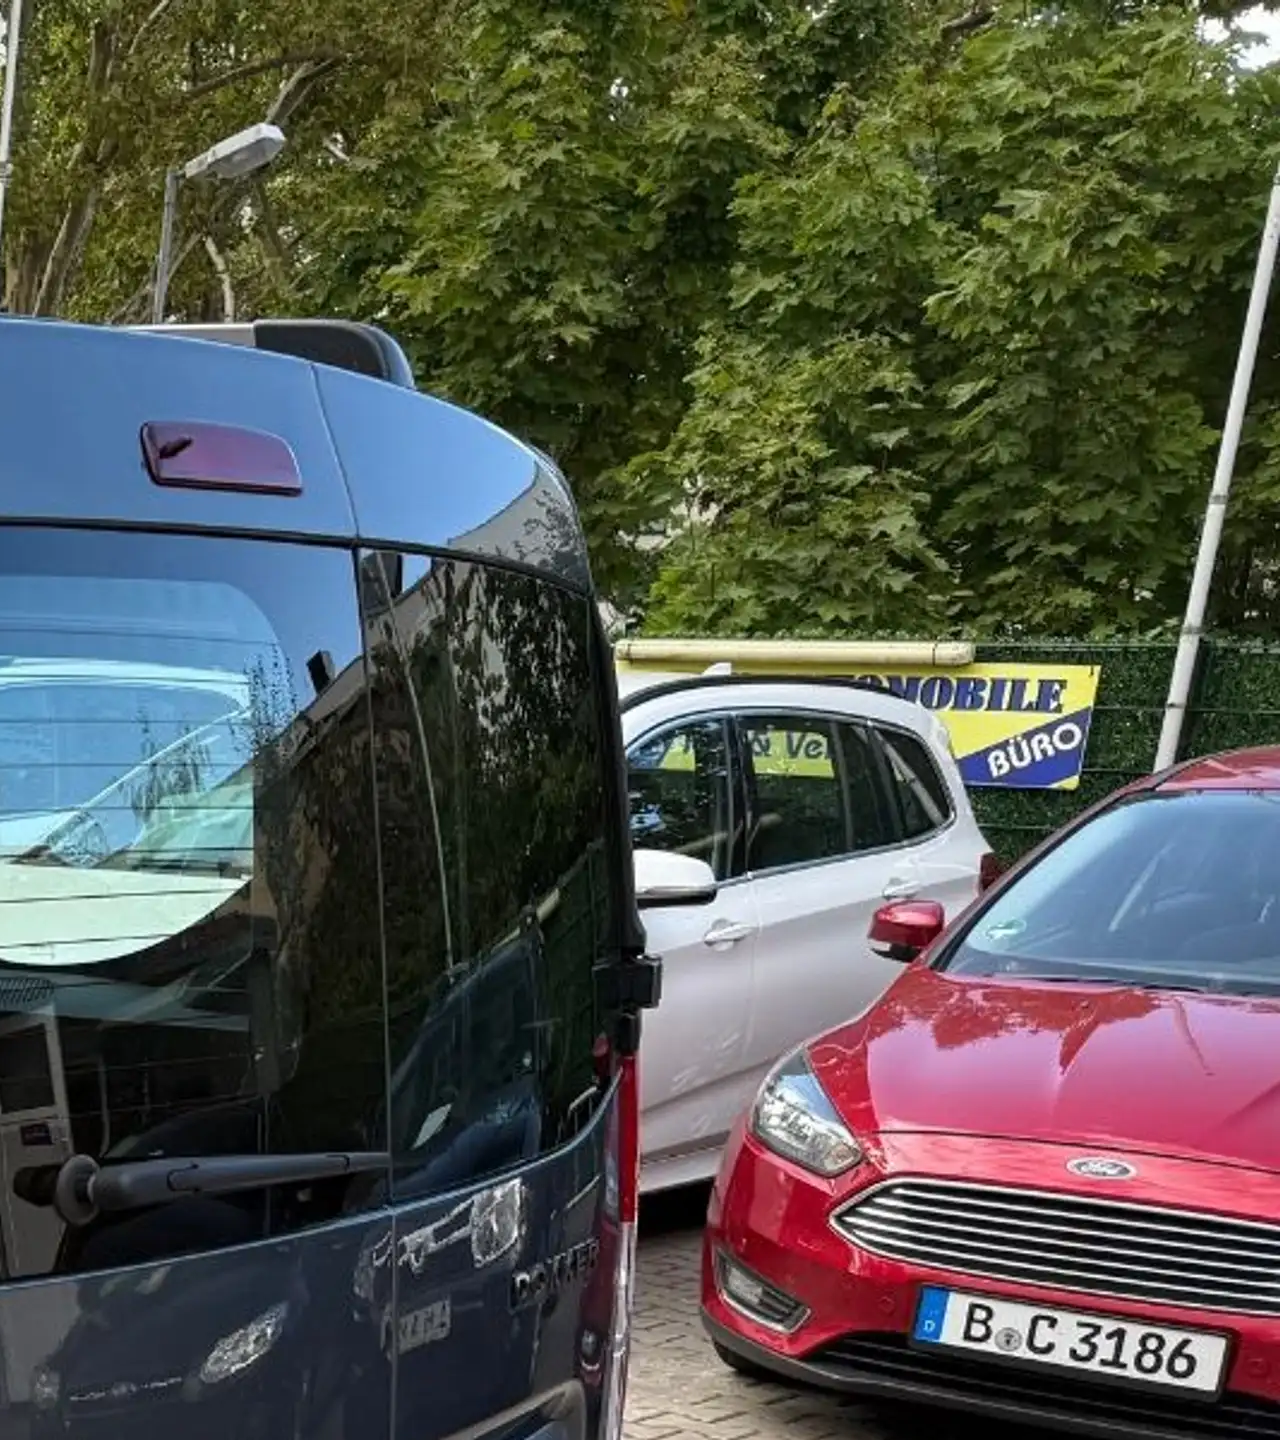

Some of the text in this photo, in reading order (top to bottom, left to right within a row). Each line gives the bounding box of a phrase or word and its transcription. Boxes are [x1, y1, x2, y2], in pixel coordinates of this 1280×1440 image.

[985, 721, 1084, 779] BÜRO
[962, 1302, 995, 1344] B
[1026, 1314, 1058, 1356] C
[1068, 1320, 1198, 1380] 3186
